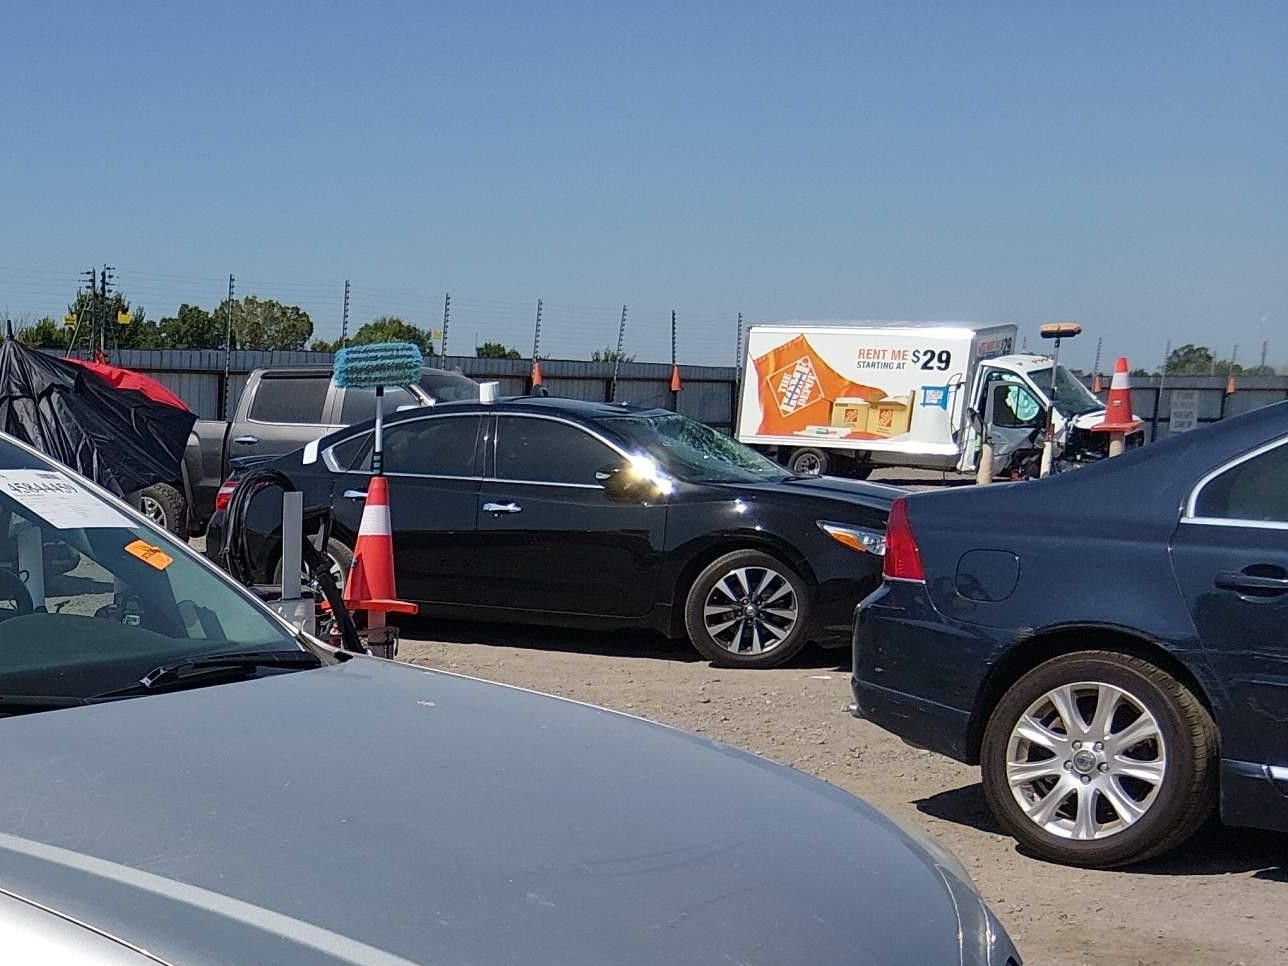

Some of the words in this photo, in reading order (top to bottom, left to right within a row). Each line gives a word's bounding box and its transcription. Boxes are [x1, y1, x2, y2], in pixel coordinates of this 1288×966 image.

[857, 361, 894, 370] STARTING
[896, 362, 906, 370] AT
[858, 348, 888, 360] RENT
[891, 350, 909, 360] ME
[912, 348, 951, 371] $29
[777, 372, 792, 393] THE
[8, 482, 79, 494] 45844459
